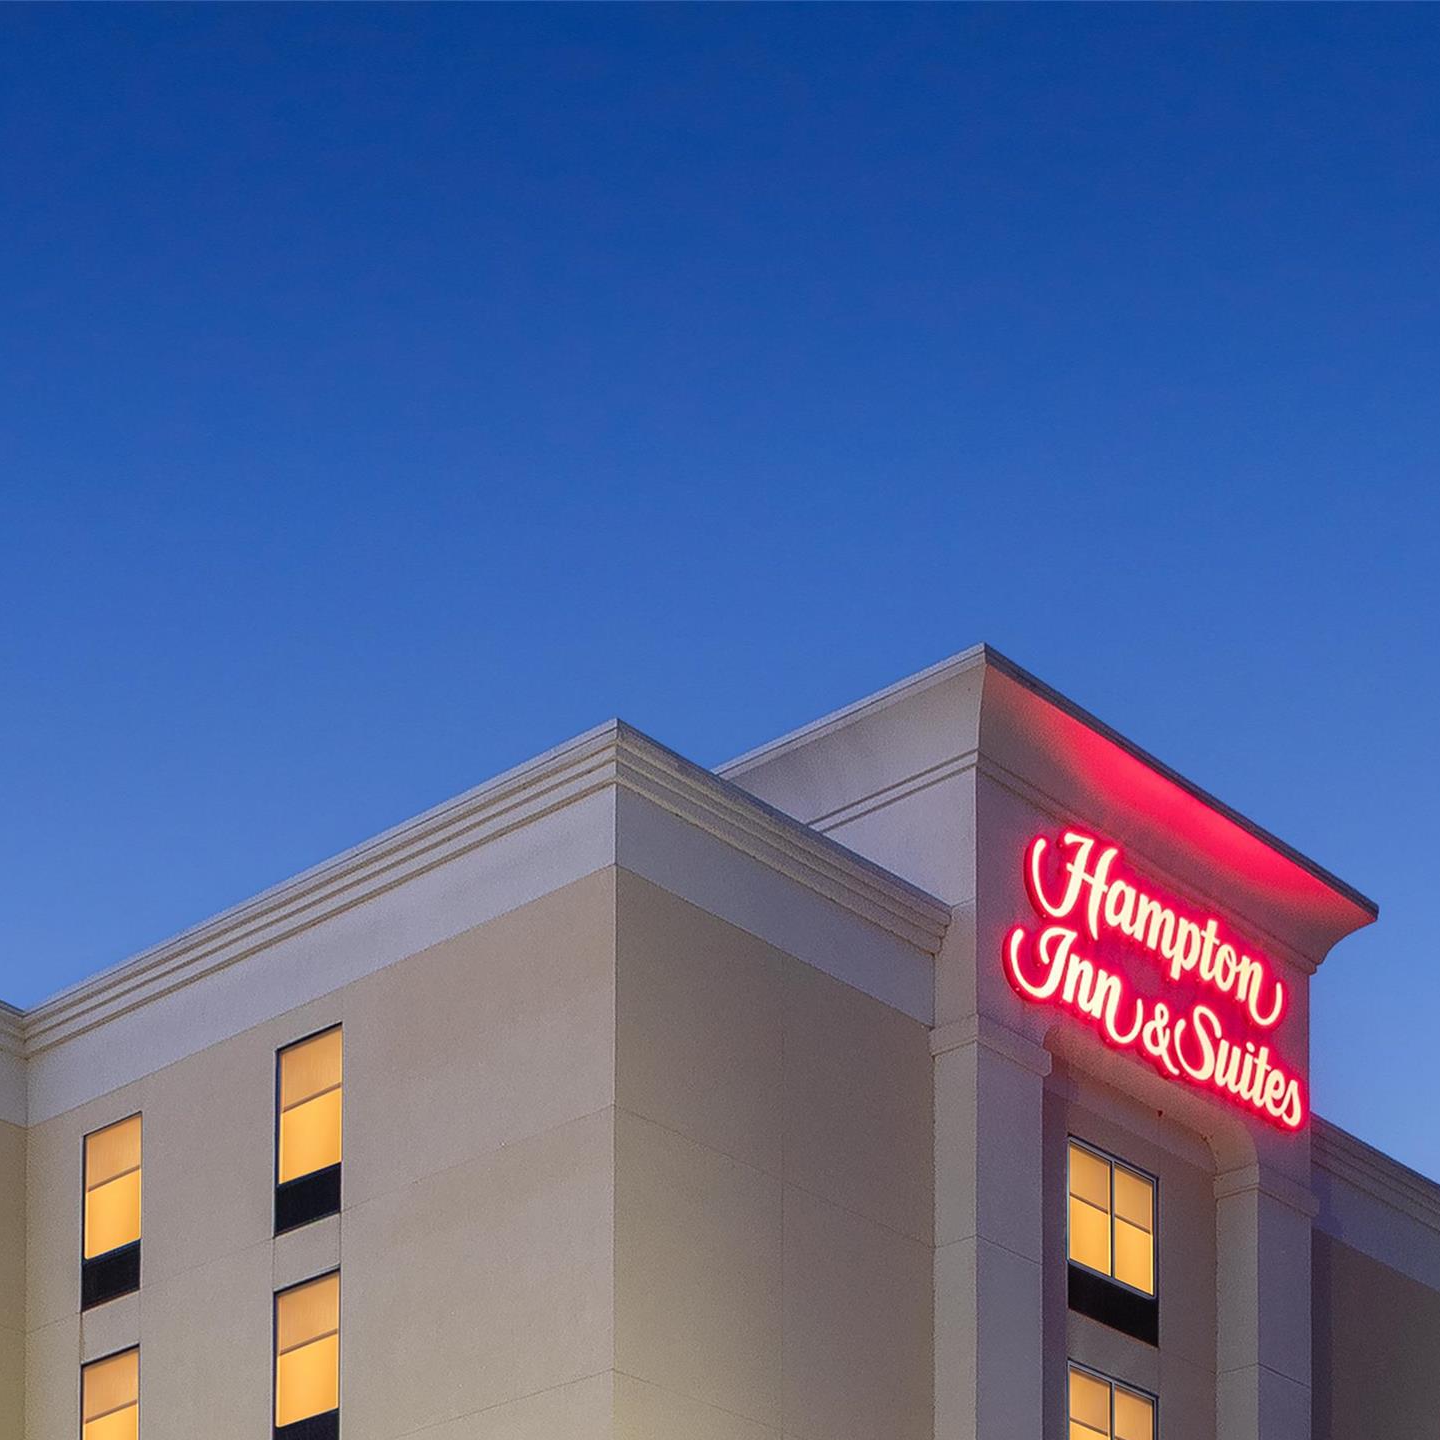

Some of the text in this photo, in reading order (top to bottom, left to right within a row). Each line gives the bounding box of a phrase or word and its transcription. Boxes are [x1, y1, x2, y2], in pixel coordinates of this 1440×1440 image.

[1009, 926, 1302, 1127] Inn & Suites
[1031, 831, 1283, 1027] Hampton
